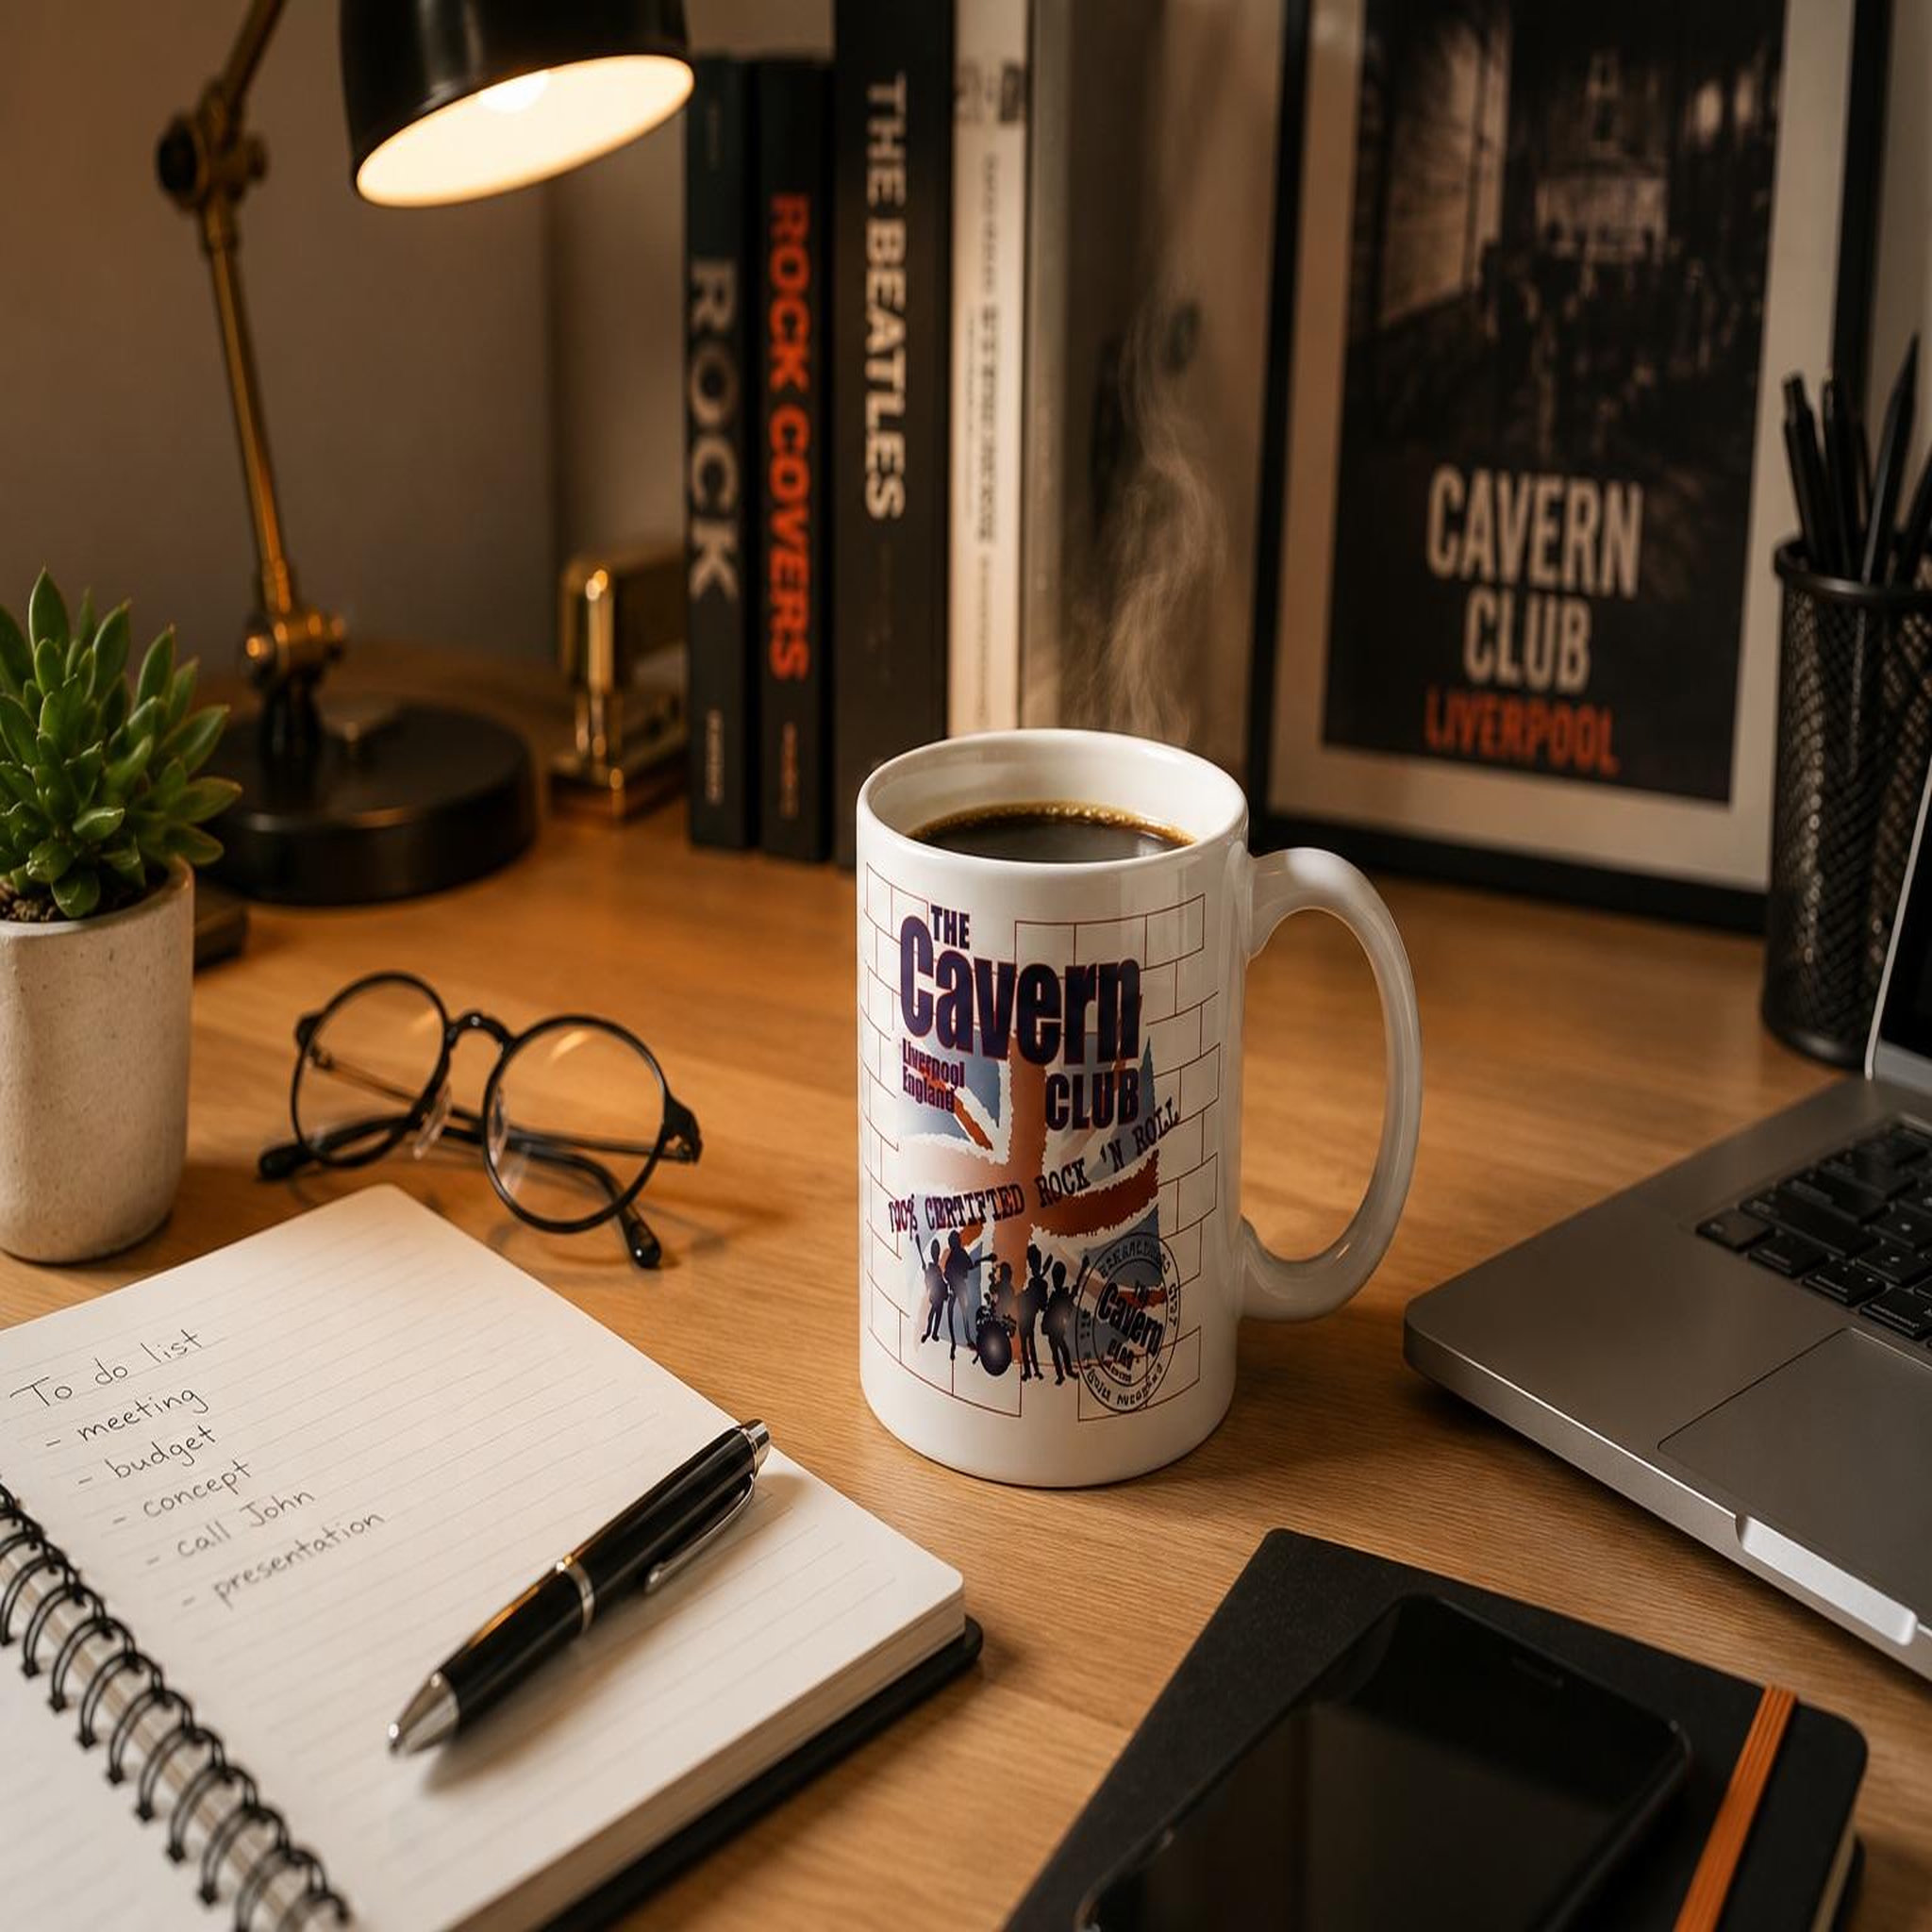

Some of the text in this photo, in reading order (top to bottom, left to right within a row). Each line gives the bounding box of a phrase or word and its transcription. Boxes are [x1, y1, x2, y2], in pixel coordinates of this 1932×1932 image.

[865, 70, 907, 207] THE
[864, 217, 907, 520] BEATLES
[689, 258, 740, 601] ROCK
[767, 193, 812, 681] ROCK COVERS
[1426, 463, 1644, 600] CAVERN
[1463, 585, 1592, 695] CLUB
[1424, 687, 1621, 776] LIVERPOOL
[930, 905, 970, 950] THE
[900, 915, 1143, 1066] Cavern
[902, 1037, 966, 1088] Liverpool
[902, 1064, 956, 1113] England
[1045, 1067, 1140, 1131] CLUB
[1034, 1158, 1091, 1208] ROCK
[1135, 1097, 1179, 1157] ROLL
[1098, 1281, 1164, 1357] Cavern
[9, 1328, 203, 1407] To do list
[77, 1389, 209, 1441] meeting
[105, 1424, 217, 1479] budget
[142, 1458, 253, 1519] concept
[176, 1519, 232, 1558] call
[239, 1489, 315, 1529] John
[213, 1513, 387, 1611] presentation
